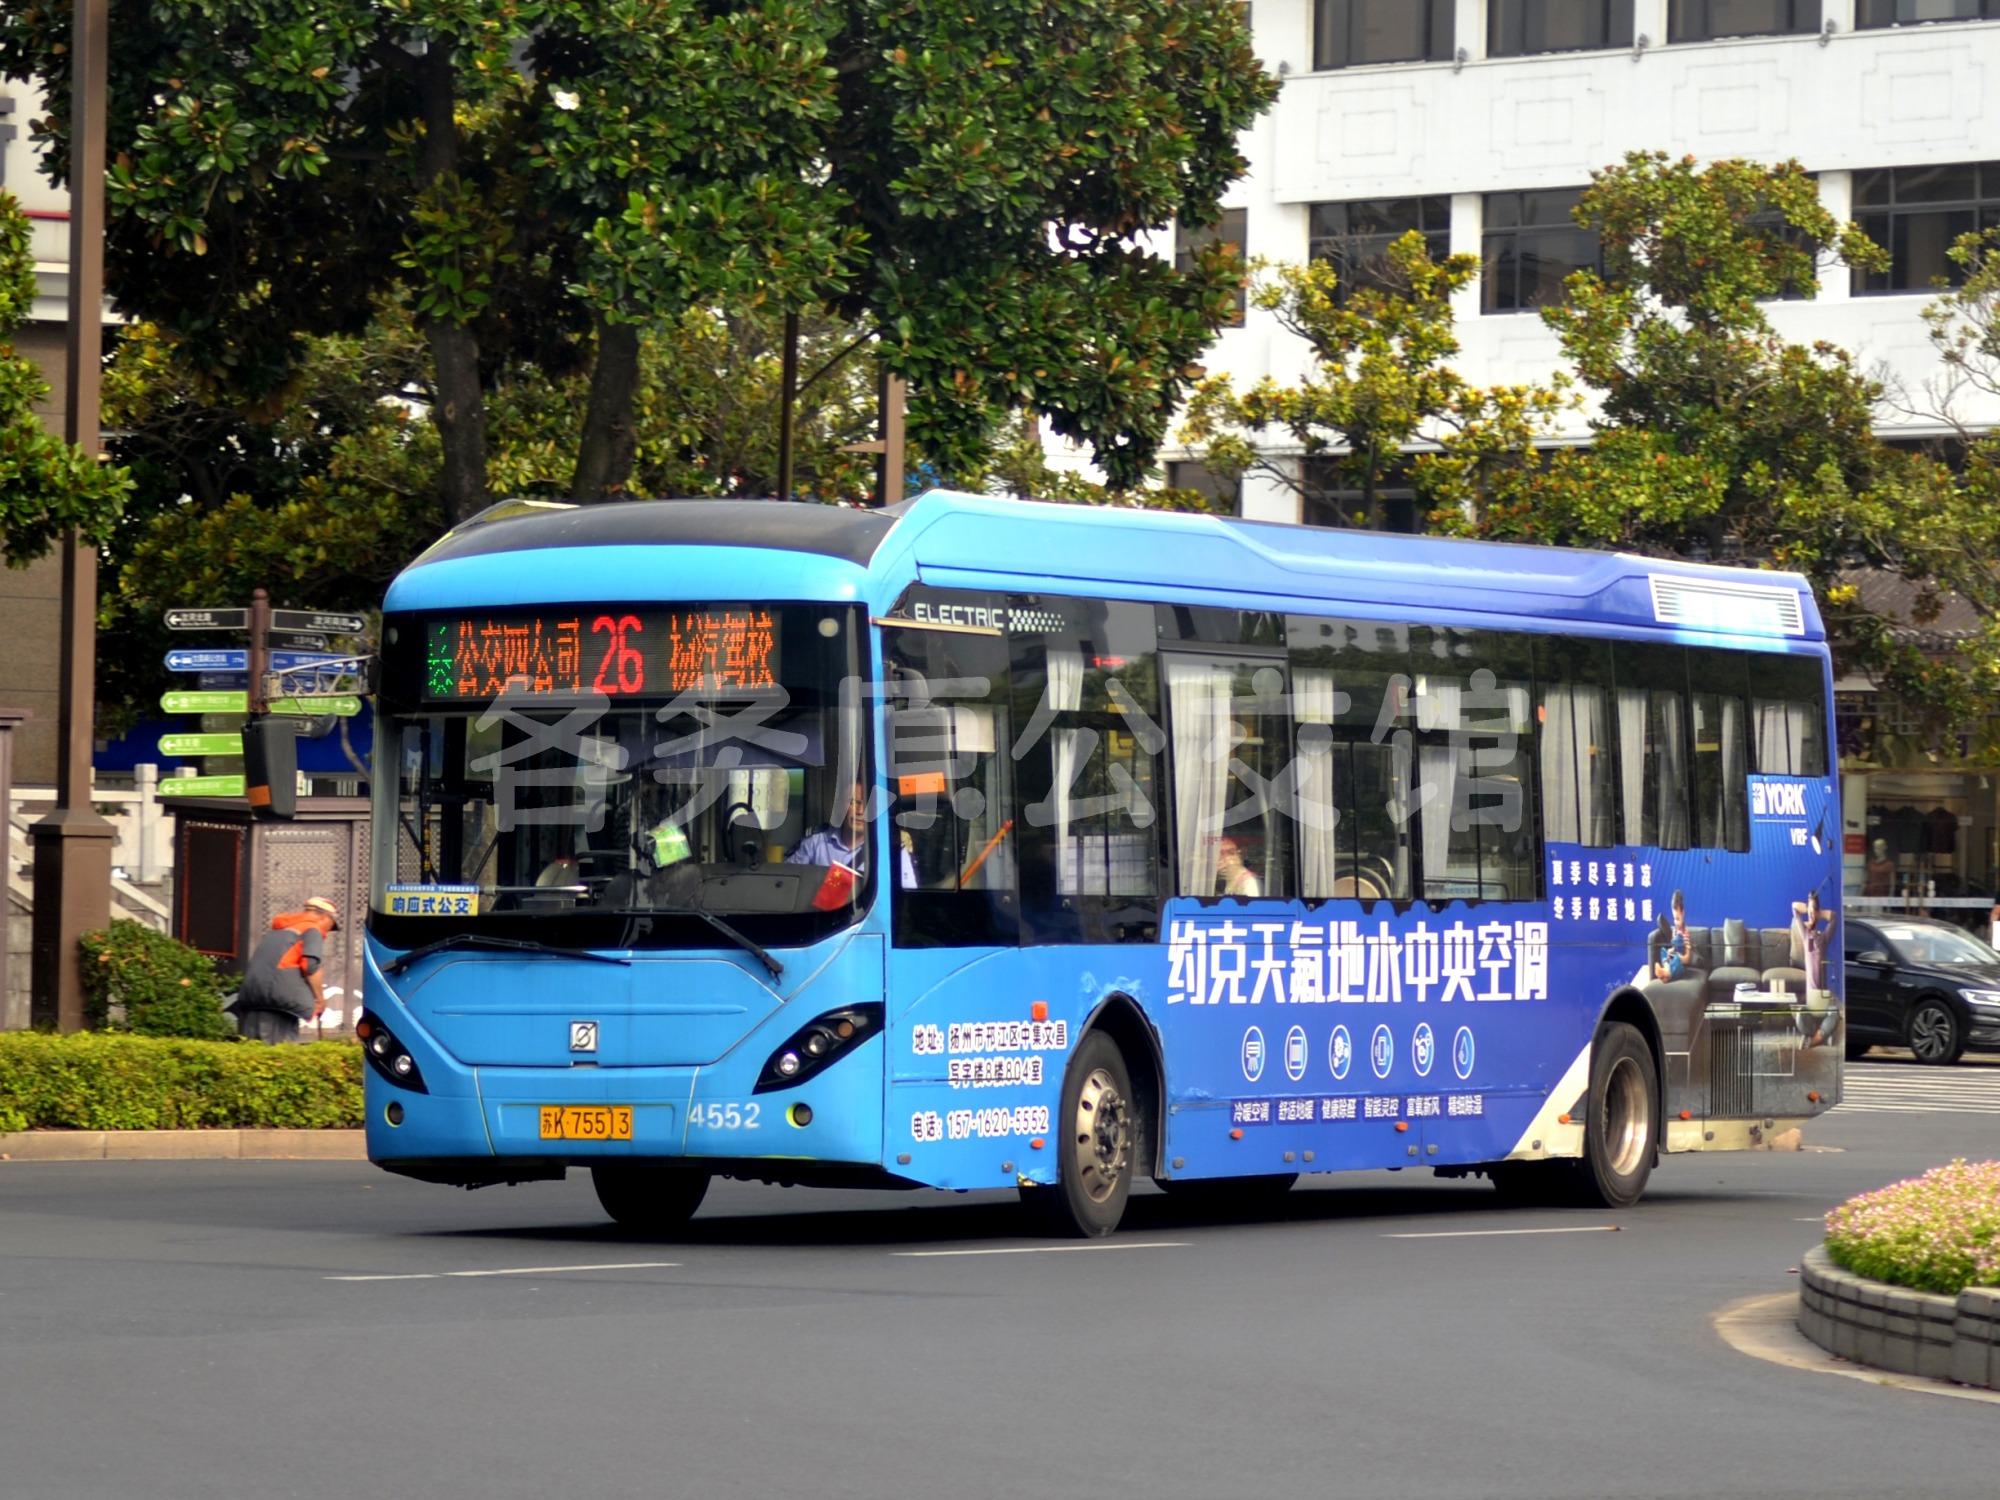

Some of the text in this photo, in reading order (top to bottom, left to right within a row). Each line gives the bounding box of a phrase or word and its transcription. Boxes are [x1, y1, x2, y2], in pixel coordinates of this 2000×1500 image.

[914, 603, 1004, 628] ELECTRIC
[592, 615, 642, 694] 26
[1765, 783, 1807, 815] YORK
[1790, 828, 1808, 846] VRF
[1552, 860, 1651, 887] 夏季尽享清凉
[392, 896, 470, 914] 响应式公交
[1553, 896, 1653, 922] 冬季舒适地暖
[1167, 920, 1549, 1005] 约克天氟地水中央空调
[689, 1103, 761, 1129] 4552
[1233, 1102, 1270, 1122] 冷暖空调
[1278, 1100, 1314, 1121] 舒适地暖
